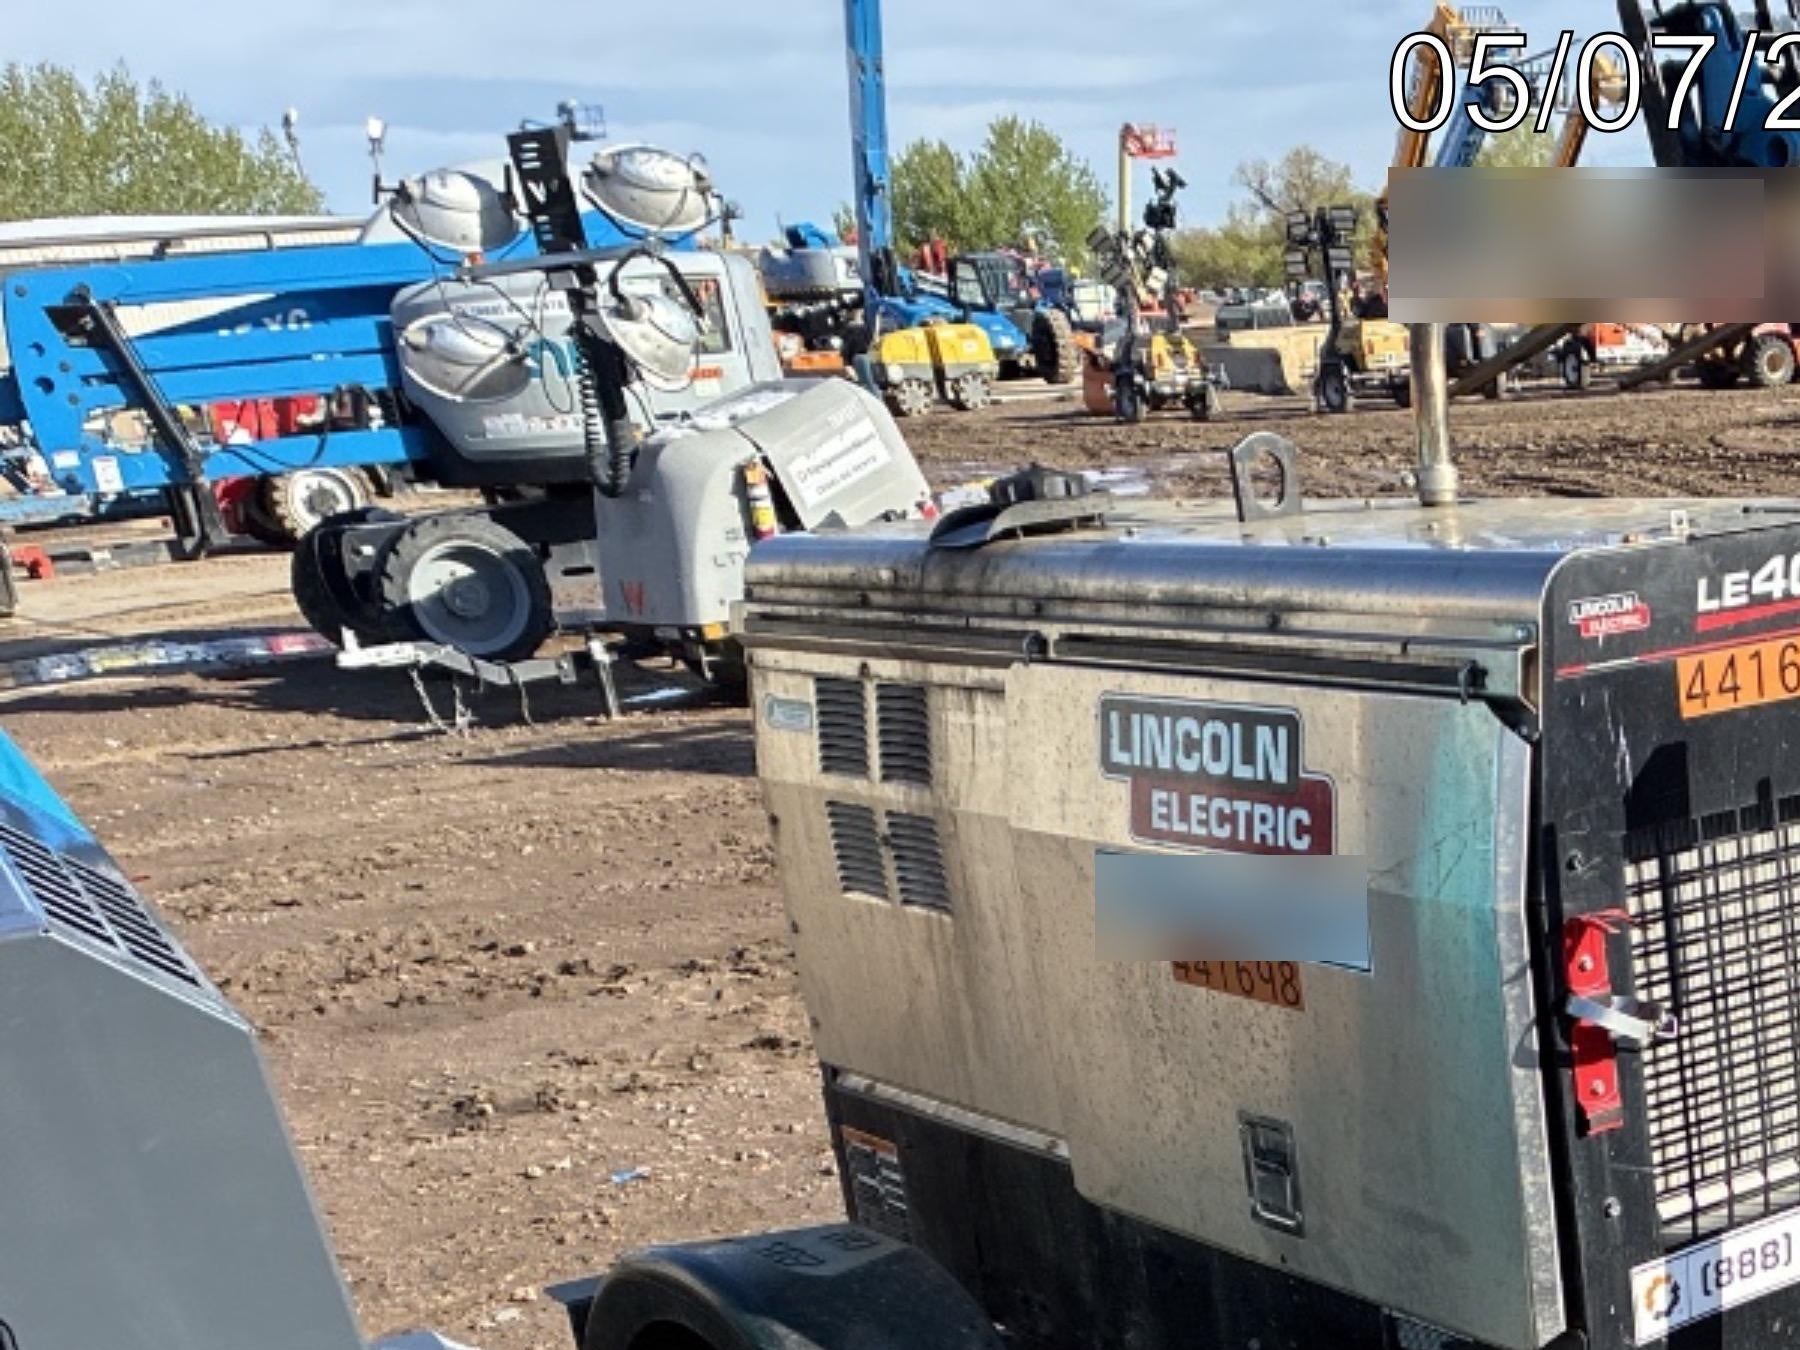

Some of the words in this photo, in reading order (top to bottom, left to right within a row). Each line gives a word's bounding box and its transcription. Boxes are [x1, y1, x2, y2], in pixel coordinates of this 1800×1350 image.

[1108, 710, 1289, 785] LINCOLN
[1150, 788, 1313, 851] ELECTRIC
[1700, 1231, 1794, 1298] (888)
